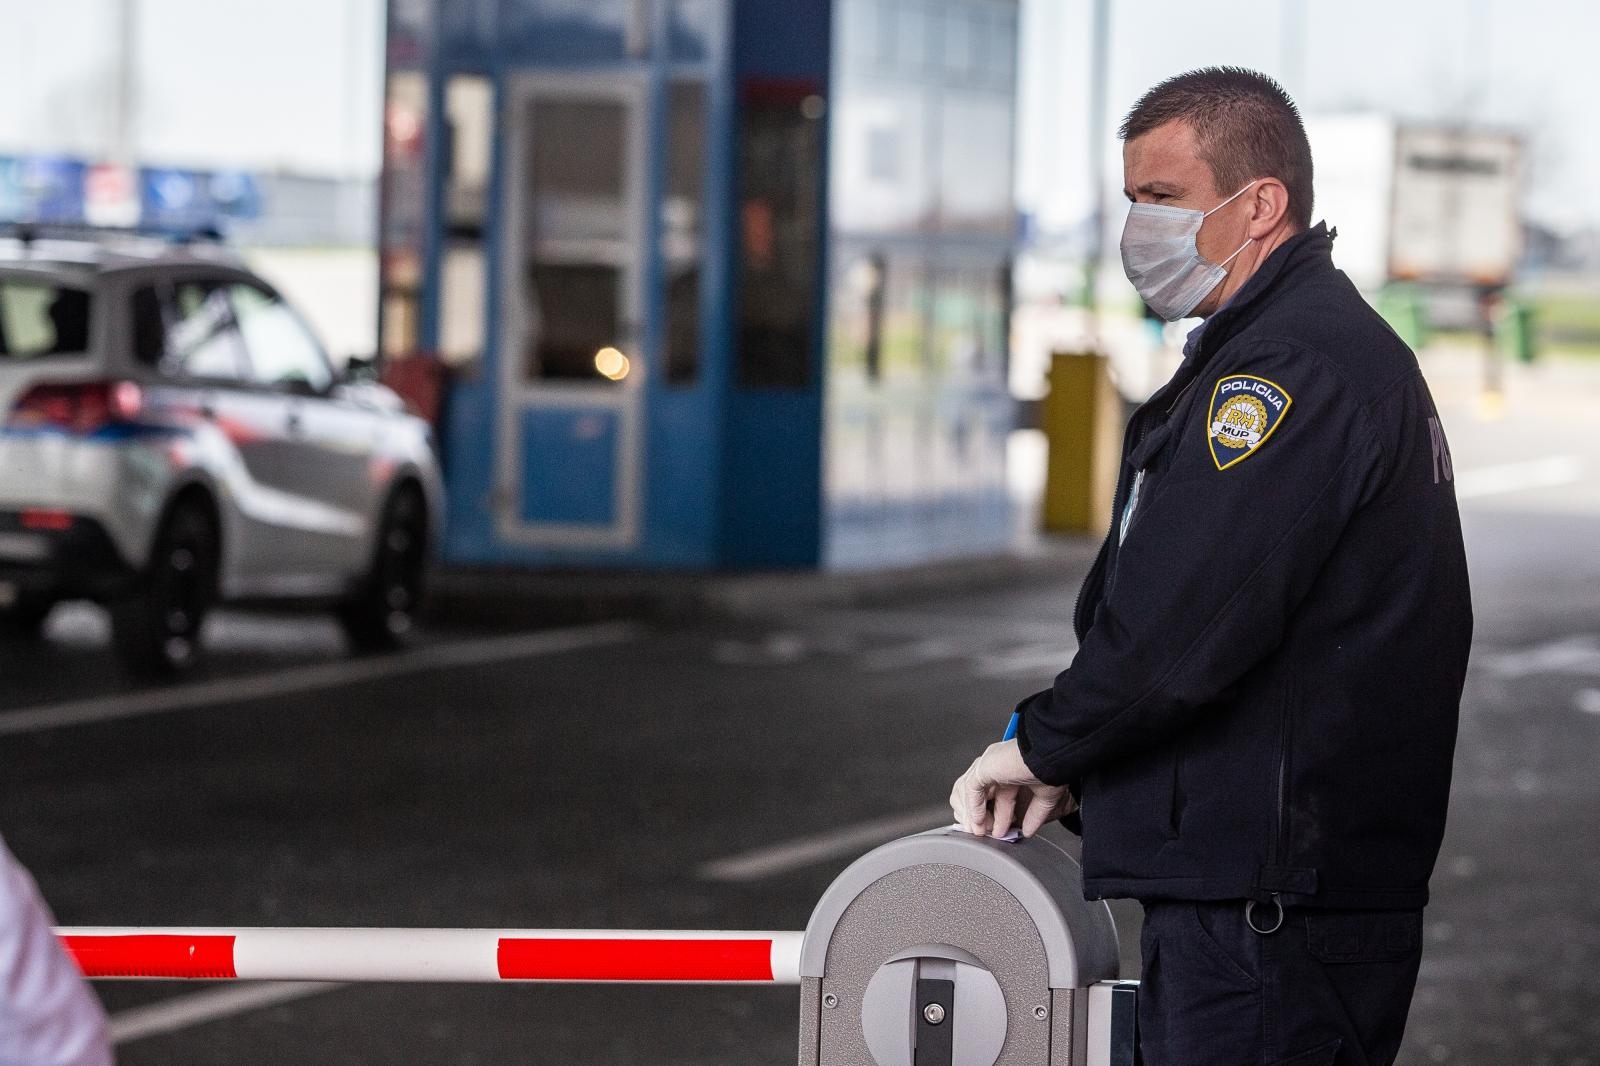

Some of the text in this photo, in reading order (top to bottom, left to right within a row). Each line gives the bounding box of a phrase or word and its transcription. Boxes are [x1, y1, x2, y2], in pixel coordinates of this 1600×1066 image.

[1221, 380, 1283, 411] POLICIJA
[1226, 409, 1255, 429] RH
[1221, 425, 1250, 438] MUP
